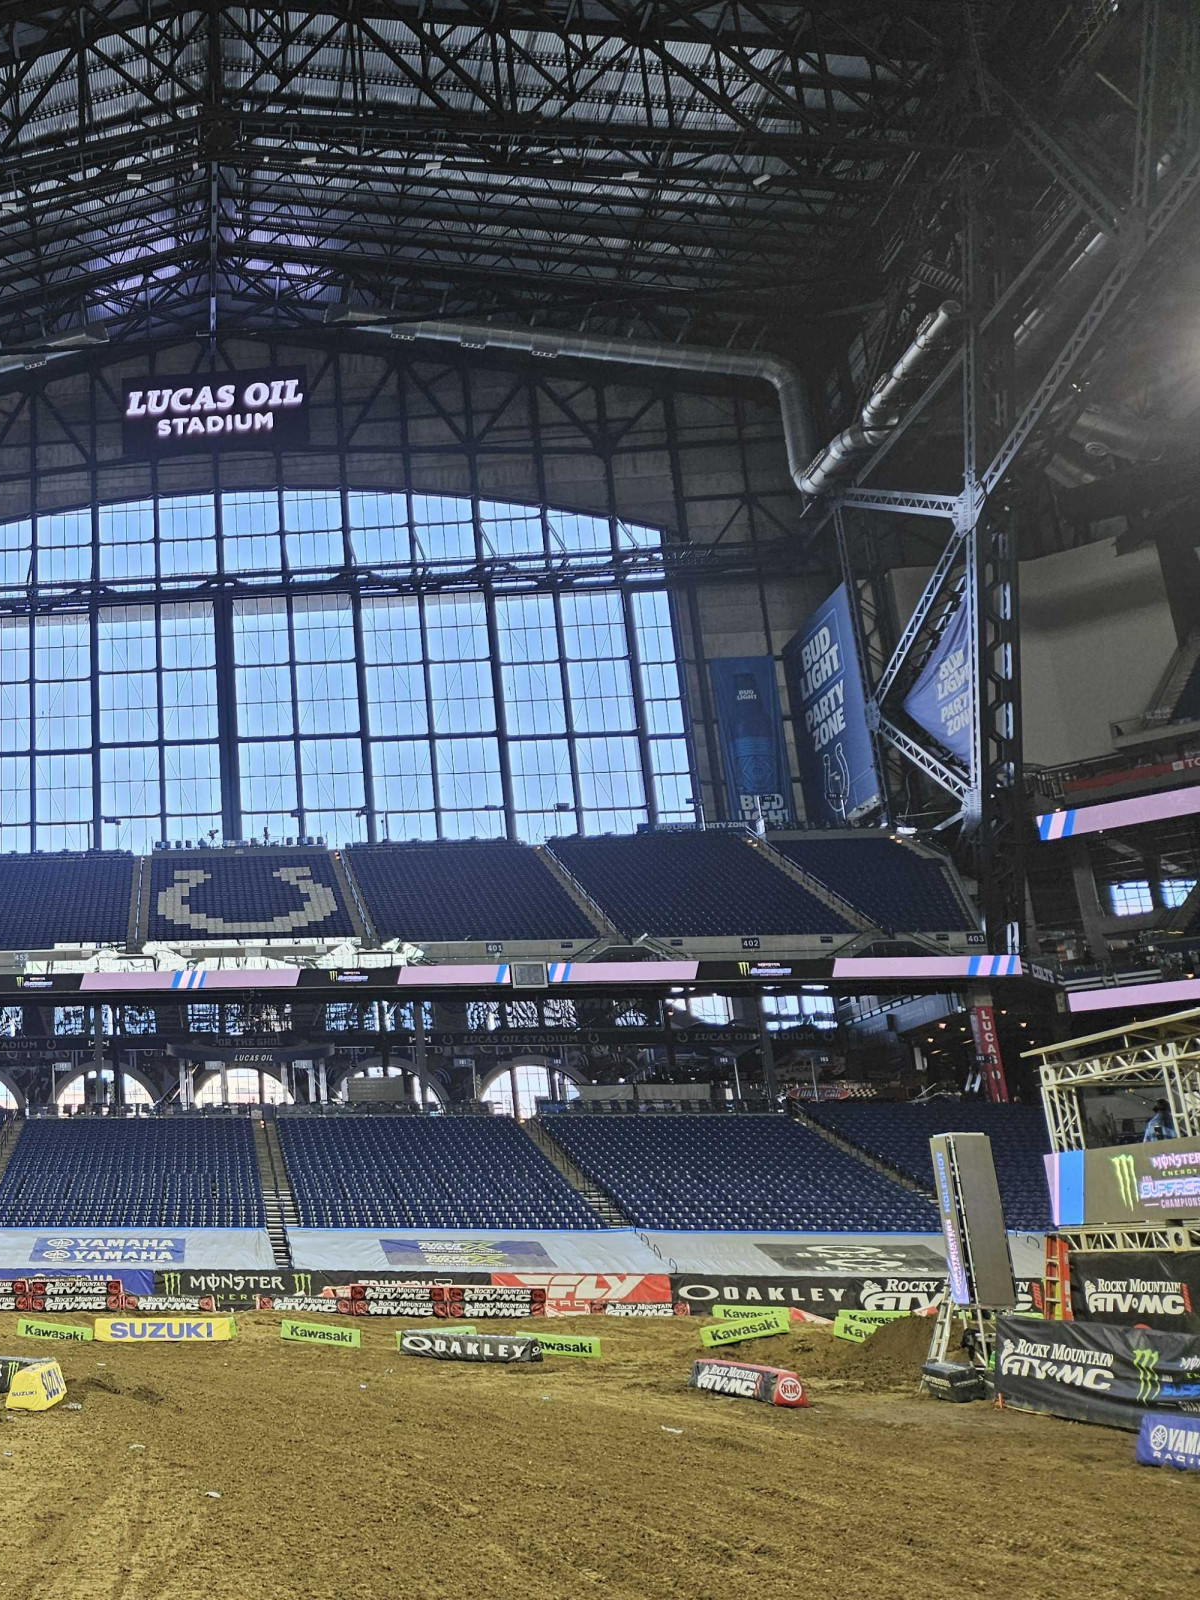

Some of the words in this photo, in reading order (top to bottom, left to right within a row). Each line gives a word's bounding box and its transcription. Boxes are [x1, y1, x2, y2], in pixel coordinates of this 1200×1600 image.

[126, 384, 236, 416] LUCAS
[244, 379, 304, 408] OIL
[157, 411, 274, 437] STADIUM
[801, 626, 831, 673] BUD
[800, 644, 840, 700] LIGHT
[805, 679, 845, 733] PARTY
[941, 691, 969, 723] PART
[814, 707, 846, 753] ZONE
[742, 939, 759, 947] 402
[967, 934, 985, 943] 403
[487, 944, 502, 952] 401
[1031, 963, 1055, 984] COLTS
[463, 1035, 499, 1044] LUCAS
[501, 1034, 522, 1043] OIL
[523, 1033, 578, 1043] STADIUM
[1162, 1168, 1198, 1177] ENERGY
[76, 1238, 174, 1247] YAMAHA
[73, 1250, 173, 1260] YAMAHA
[190, 1273, 285, 1291] MONSTER
[514, 1274, 646, 1299] FLY
[885, 1278, 939, 1292] ROCKY
[1098, 1278, 1128, 1293] ROCKY
[1129, 1278, 1181, 1294] MOUNTAIN
[724, 1286, 845, 1302] OAKLEY
[25, 1325, 85, 1341] Kawasaki
[110, 1322, 213, 1338] SUZUKI
[290, 1325, 352, 1343] Kawasaki
[710, 1317, 780, 1341] Kawasaki
[434, 1340, 526, 1358] OAKLEY
[1015, 1338, 1050, 1361] ROCKY
[1052, 1343, 1114, 1367] MOUNTAIN
[710, 1364, 729, 1377] ROCKY
[727, 1366, 761, 1381] MOUNTAIN
[783, 1385, 797, 1393] RM
